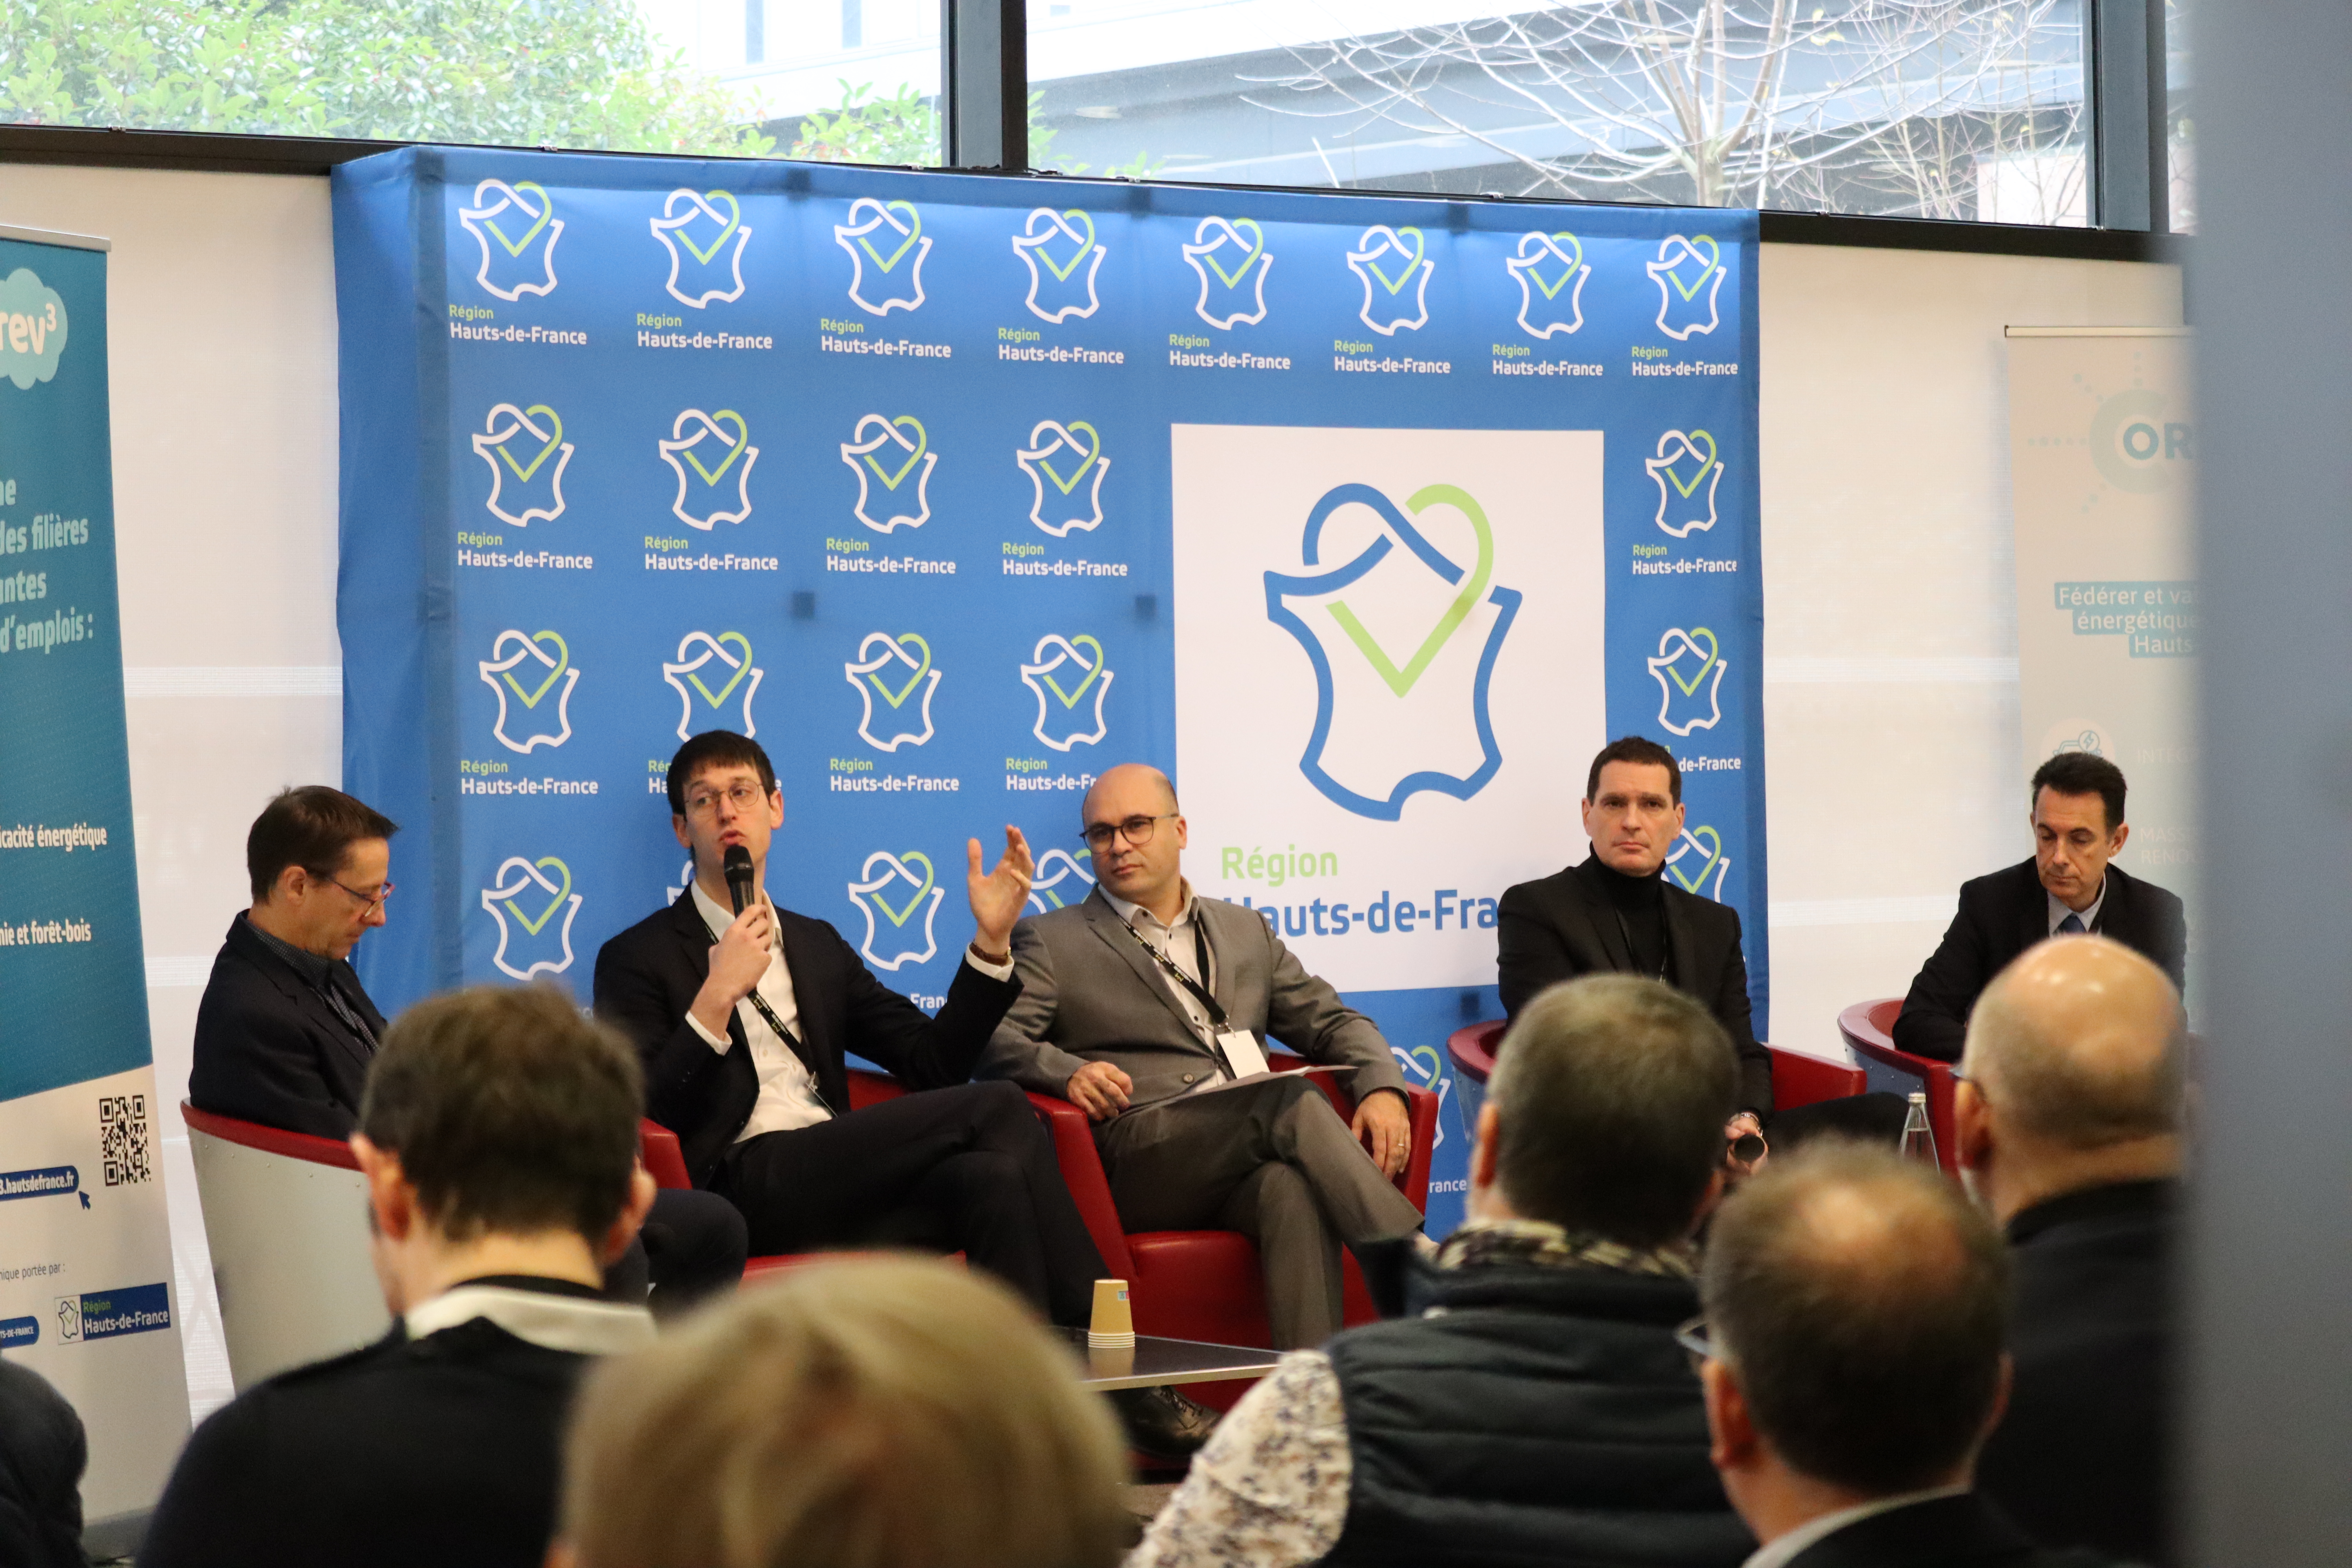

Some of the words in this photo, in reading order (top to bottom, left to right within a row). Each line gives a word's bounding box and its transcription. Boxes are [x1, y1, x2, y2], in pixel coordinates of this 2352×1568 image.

[449, 304, 494, 321] Région
[637, 313, 682, 329] Région
[821, 318, 864, 335] Région
[450, 322, 587, 345] Hauts-de-France
[638, 331, 773, 349] Hauts-de-France
[998, 327, 1040, 343] Région
[1169, 334, 1210, 349] Région
[821, 335, 951, 358] Hauts-de-France
[999, 344, 1124, 364] Hauts-de-France
[1334, 340, 1373, 355] Région
[1493, 344, 1530, 358] Région
[1632, 346, 1668, 360] Région
[1170, 350, 1291, 370] Hauts-de-France
[1334, 356, 1451, 374] Hauts-de-France
[1493, 360, 1603, 376] Hauts-de-France
[1632, 361, 1738, 376] Hauts-de-France
[31, 513, 89, 550] filières
[457, 532, 503, 548] Région
[645, 536, 688, 552] Région
[826, 538, 869, 554] Région
[1003, 543, 1044, 557] Région
[1633, 544, 1667, 558] Région
[458, 550, 593, 569] Hauts-de-France
[645, 554, 778, 570] Hauts-de-France
[827, 555, 956, 574] Hauts-de-France
[1003, 559, 1127, 576] Hauts-de-France
[1633, 558, 1737, 574] Hauts-de-France
[2060, 587, 2137, 605] Fédérer
[2144, 588, 2163, 604] et
[461, 760, 508, 776] Région
[830, 758, 873, 774] Région
[1006, 757, 1047, 773] Région
[461, 778, 598, 794] Hauts-de-France
[831, 775, 959, 791] Hauts-de-France
[1007, 774, 1097, 790] Hauts-de-Fr
[37, 822, 107, 852] énergétique
[1221, 844, 1338, 887] Région
[17, 924, 30, 945] et
[31, 918, 91, 944] forêt-bois
[22, 1265, 46, 1280] portée
[49, 1264, 60, 1276] par
[83, 1299, 111, 1314] Région
[84, 1311, 168, 1334] Hauts-de-France
